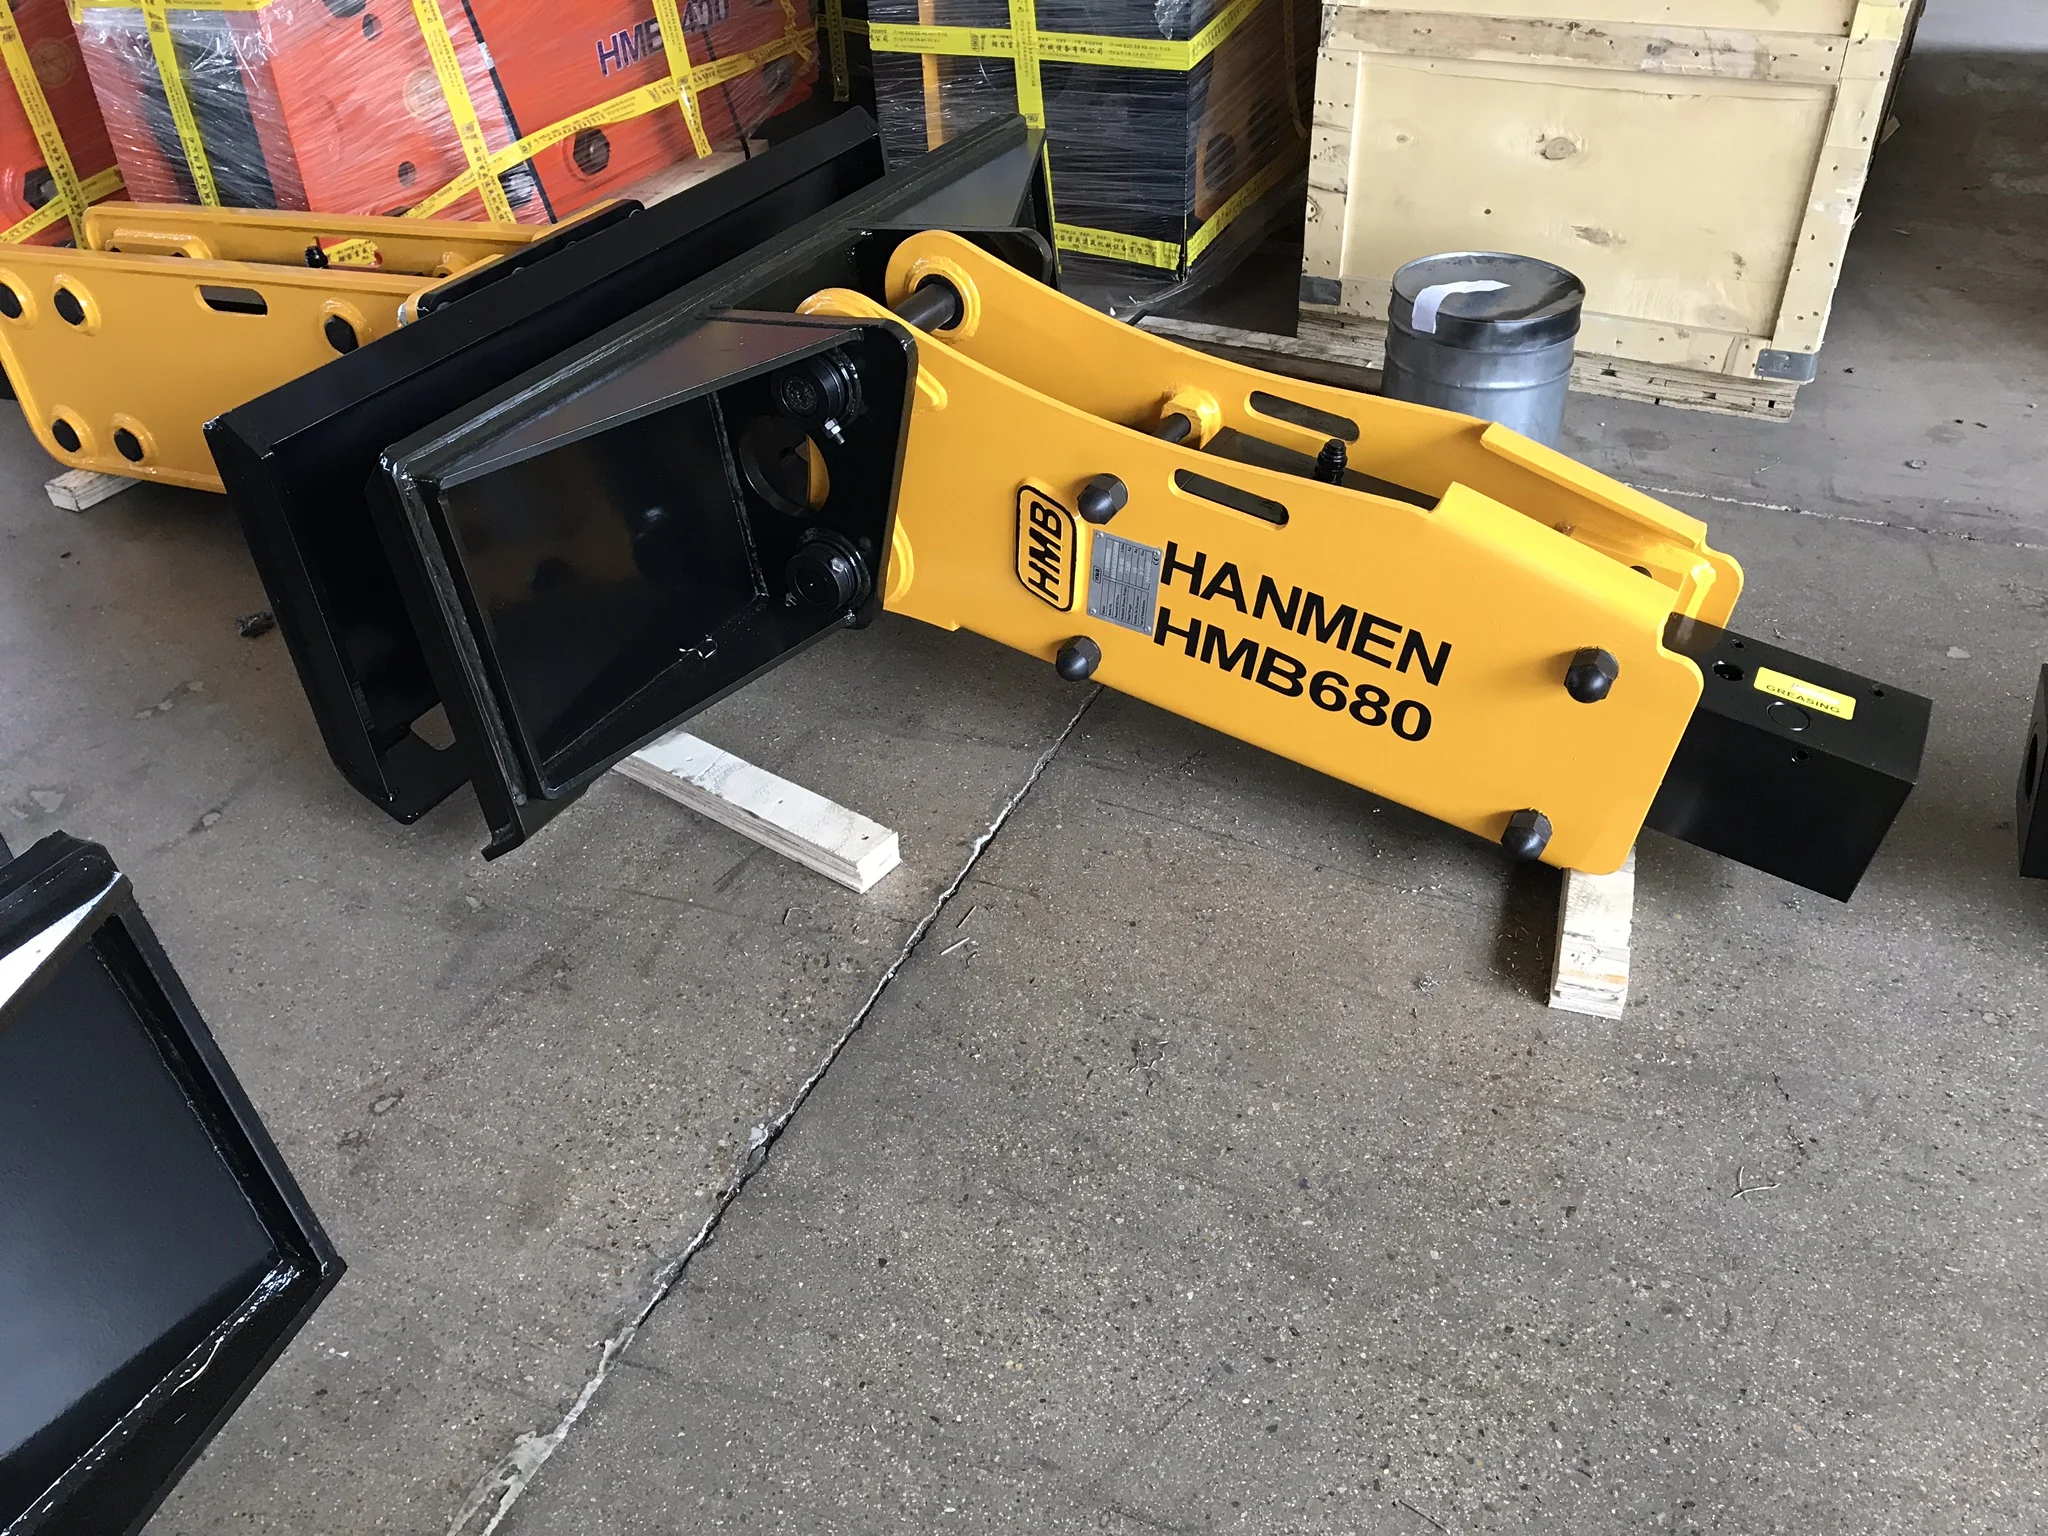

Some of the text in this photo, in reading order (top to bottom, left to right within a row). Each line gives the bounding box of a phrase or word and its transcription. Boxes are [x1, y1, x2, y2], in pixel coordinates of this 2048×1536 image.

[1028, 501, 1062, 602] HMB
[1160, 540, 1453, 687] HANMEN
[1153, 605, 1432, 742] HMB680
[1766, 684, 1840, 714] GREASING
